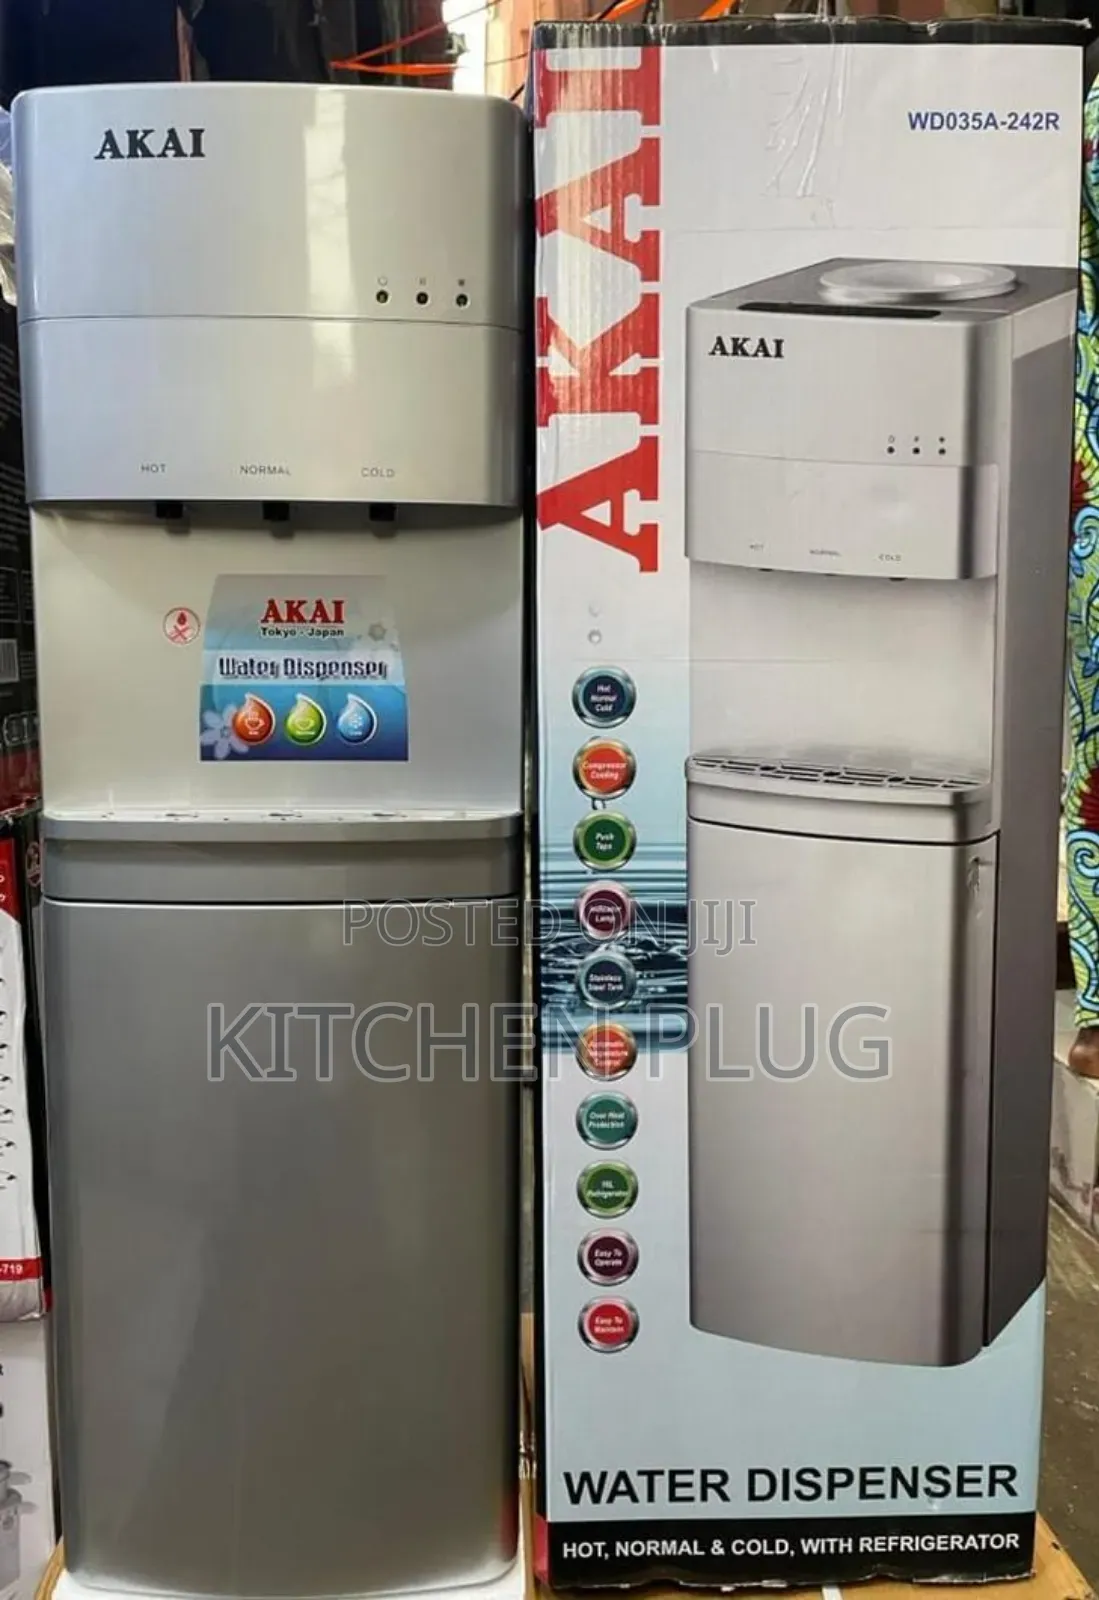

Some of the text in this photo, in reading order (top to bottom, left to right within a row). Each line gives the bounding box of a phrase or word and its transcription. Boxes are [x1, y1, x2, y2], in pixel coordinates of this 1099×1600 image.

[907, 110, 1061, 132] WD035A-242R
[94, 127, 206, 160] AKAI
[535, 45, 661, 573] AKAI
[708, 335, 785, 360] AKAI
[140, 463, 167, 474] HOT
[239, 464, 292, 476] NORMAL
[360, 466, 396, 478] COLD
[261, 598, 345, 624] AKAI
[261, 627, 297, 638] Tokyo
[308, 627, 345, 638] Japan
[218, 657, 388, 681] Water Dispenser
[562, 1464, 1019, 1505] WATER DISPENSER
[562, 1533, 1019, 1560] HOT, NORMAL & COLD, WITH REFRIGERATOR
